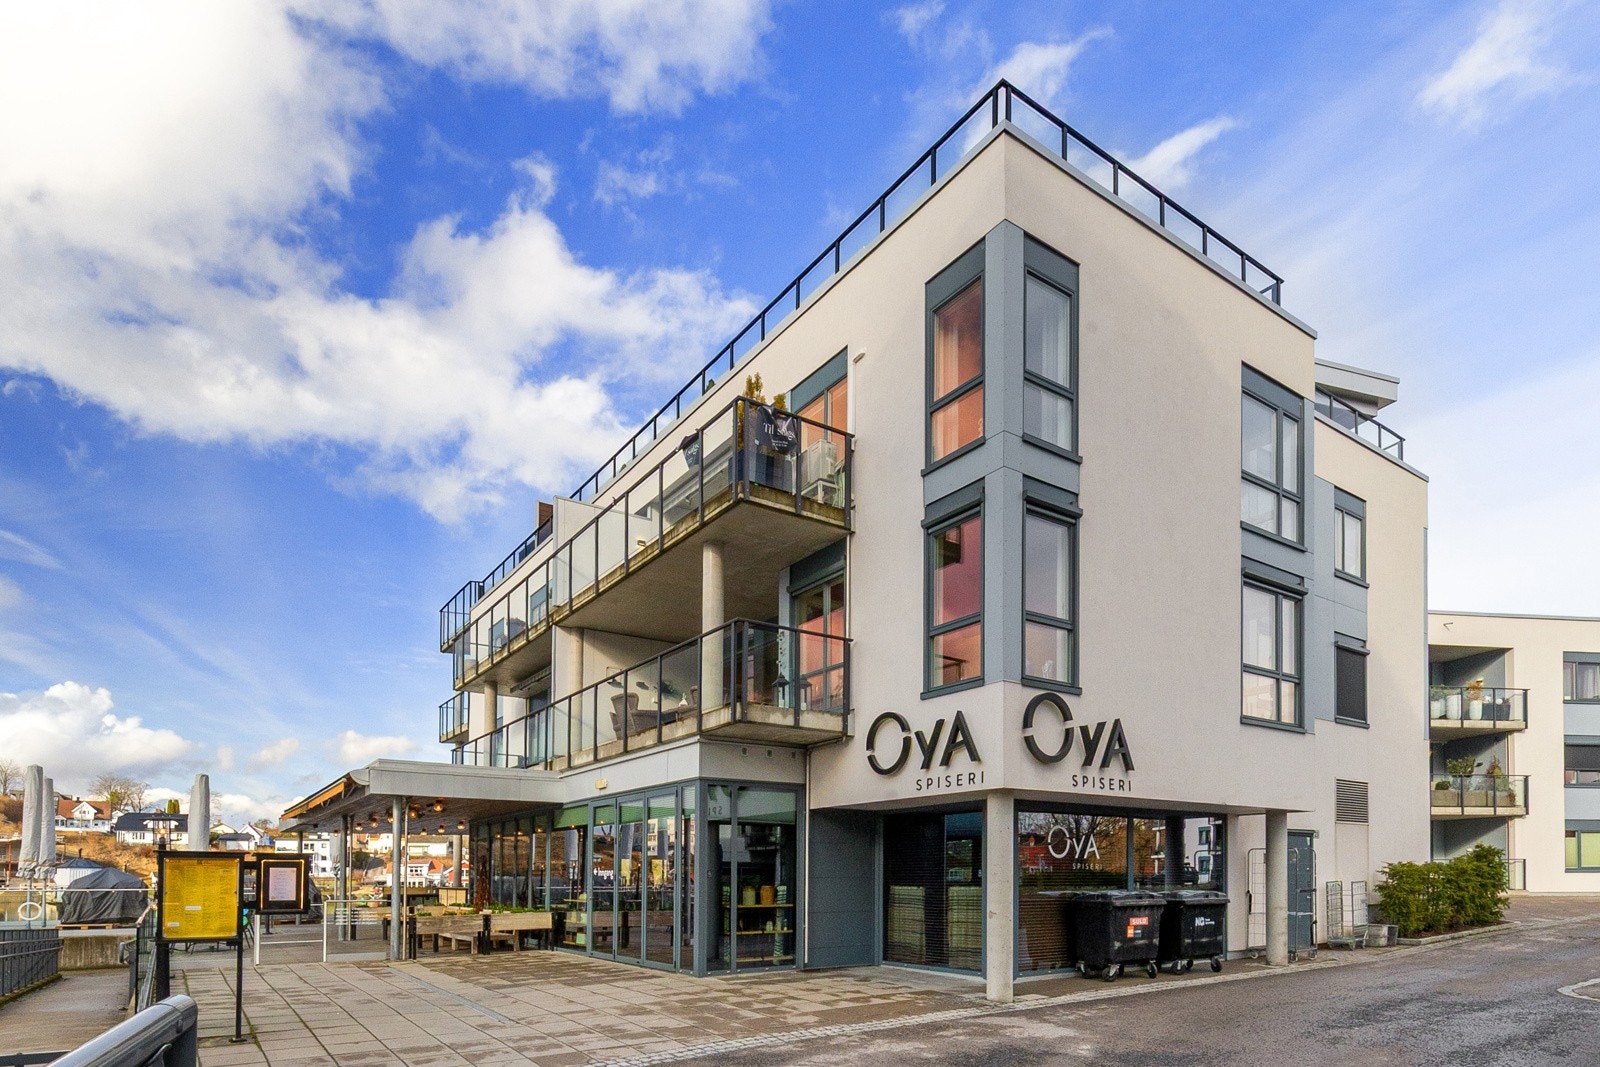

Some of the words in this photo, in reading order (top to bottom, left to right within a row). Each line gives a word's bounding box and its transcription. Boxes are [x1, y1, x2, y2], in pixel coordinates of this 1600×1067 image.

[916, 771, 984, 791] SPISERI
[1072, 775, 1132, 792] SPISERI
[1072, 862, 1103, 870] SPISERI
